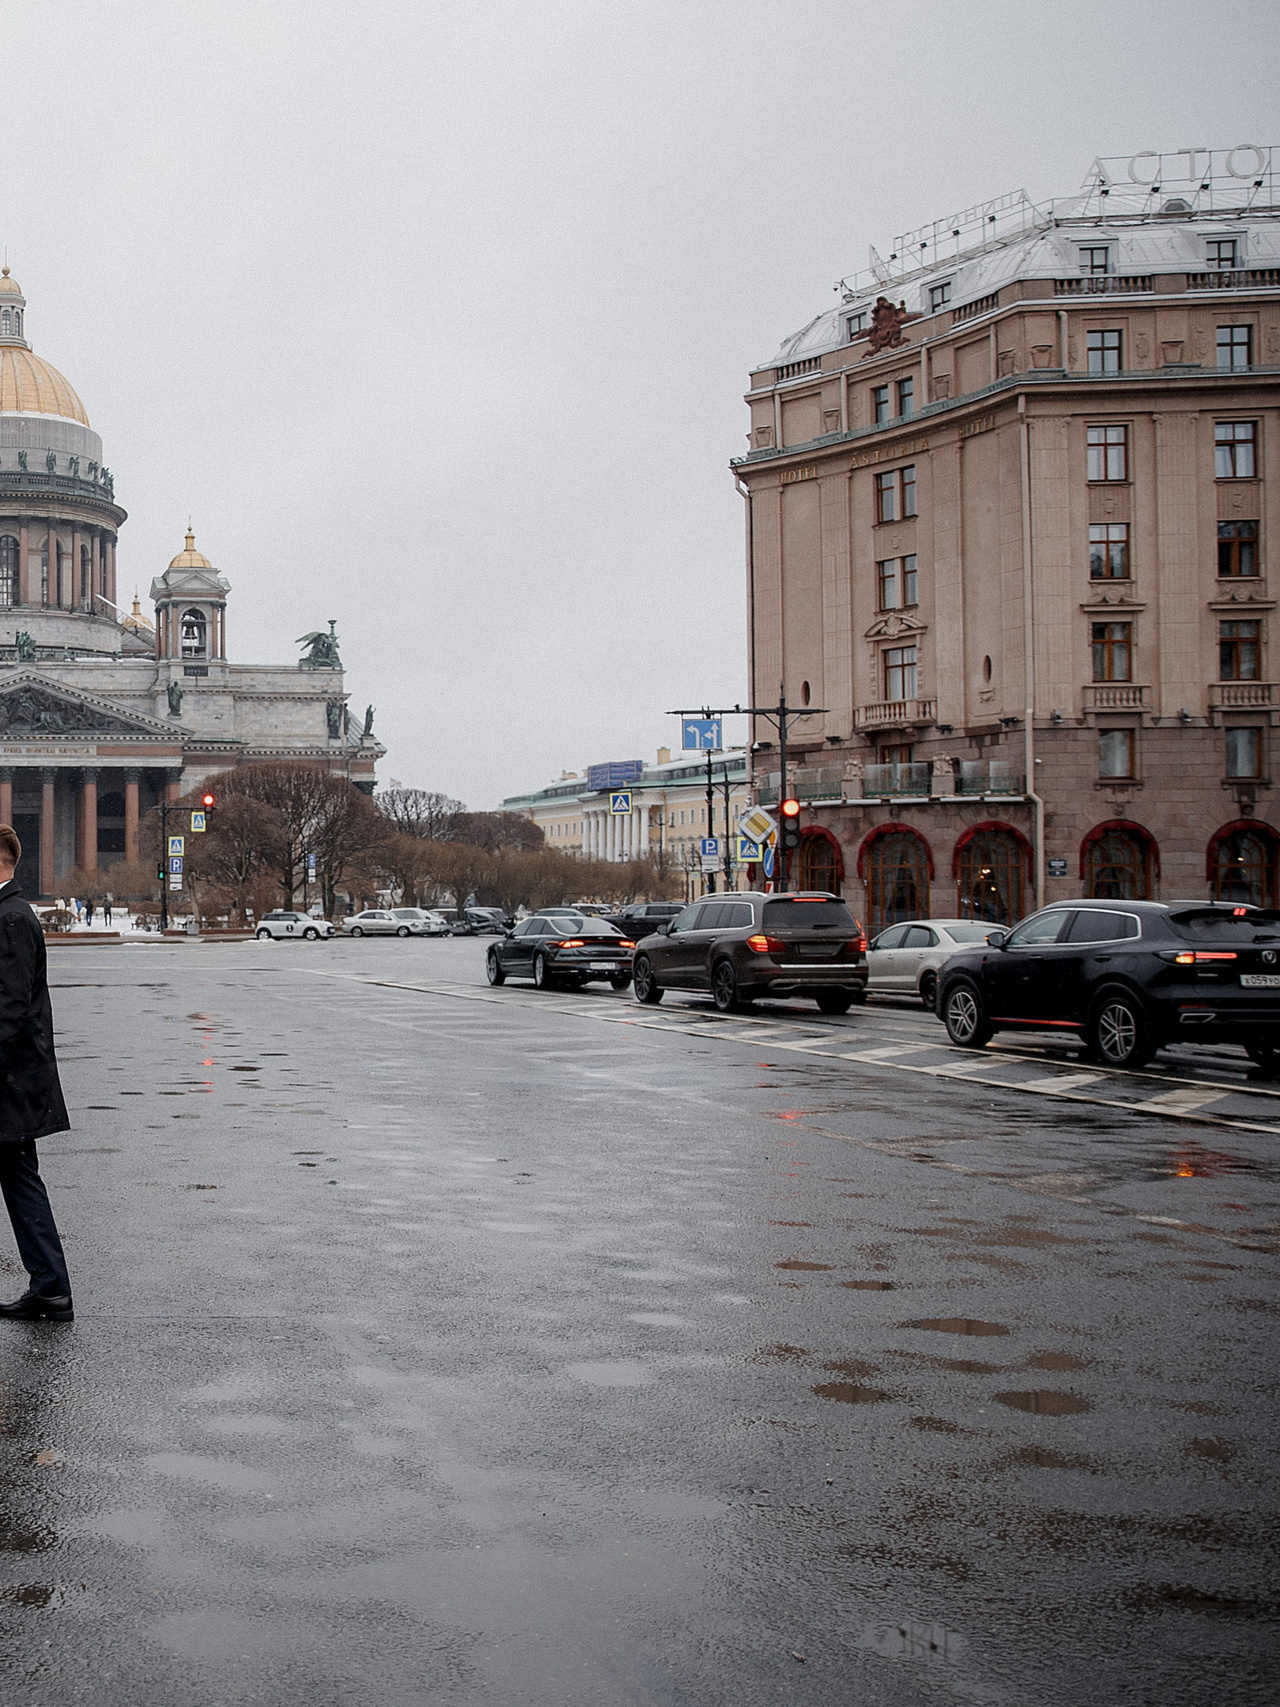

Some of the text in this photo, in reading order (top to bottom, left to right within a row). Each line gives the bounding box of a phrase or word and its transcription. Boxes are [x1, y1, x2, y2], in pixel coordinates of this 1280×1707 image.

[780, 415, 996, 483] HOTEL ASTORIA HOTEL
